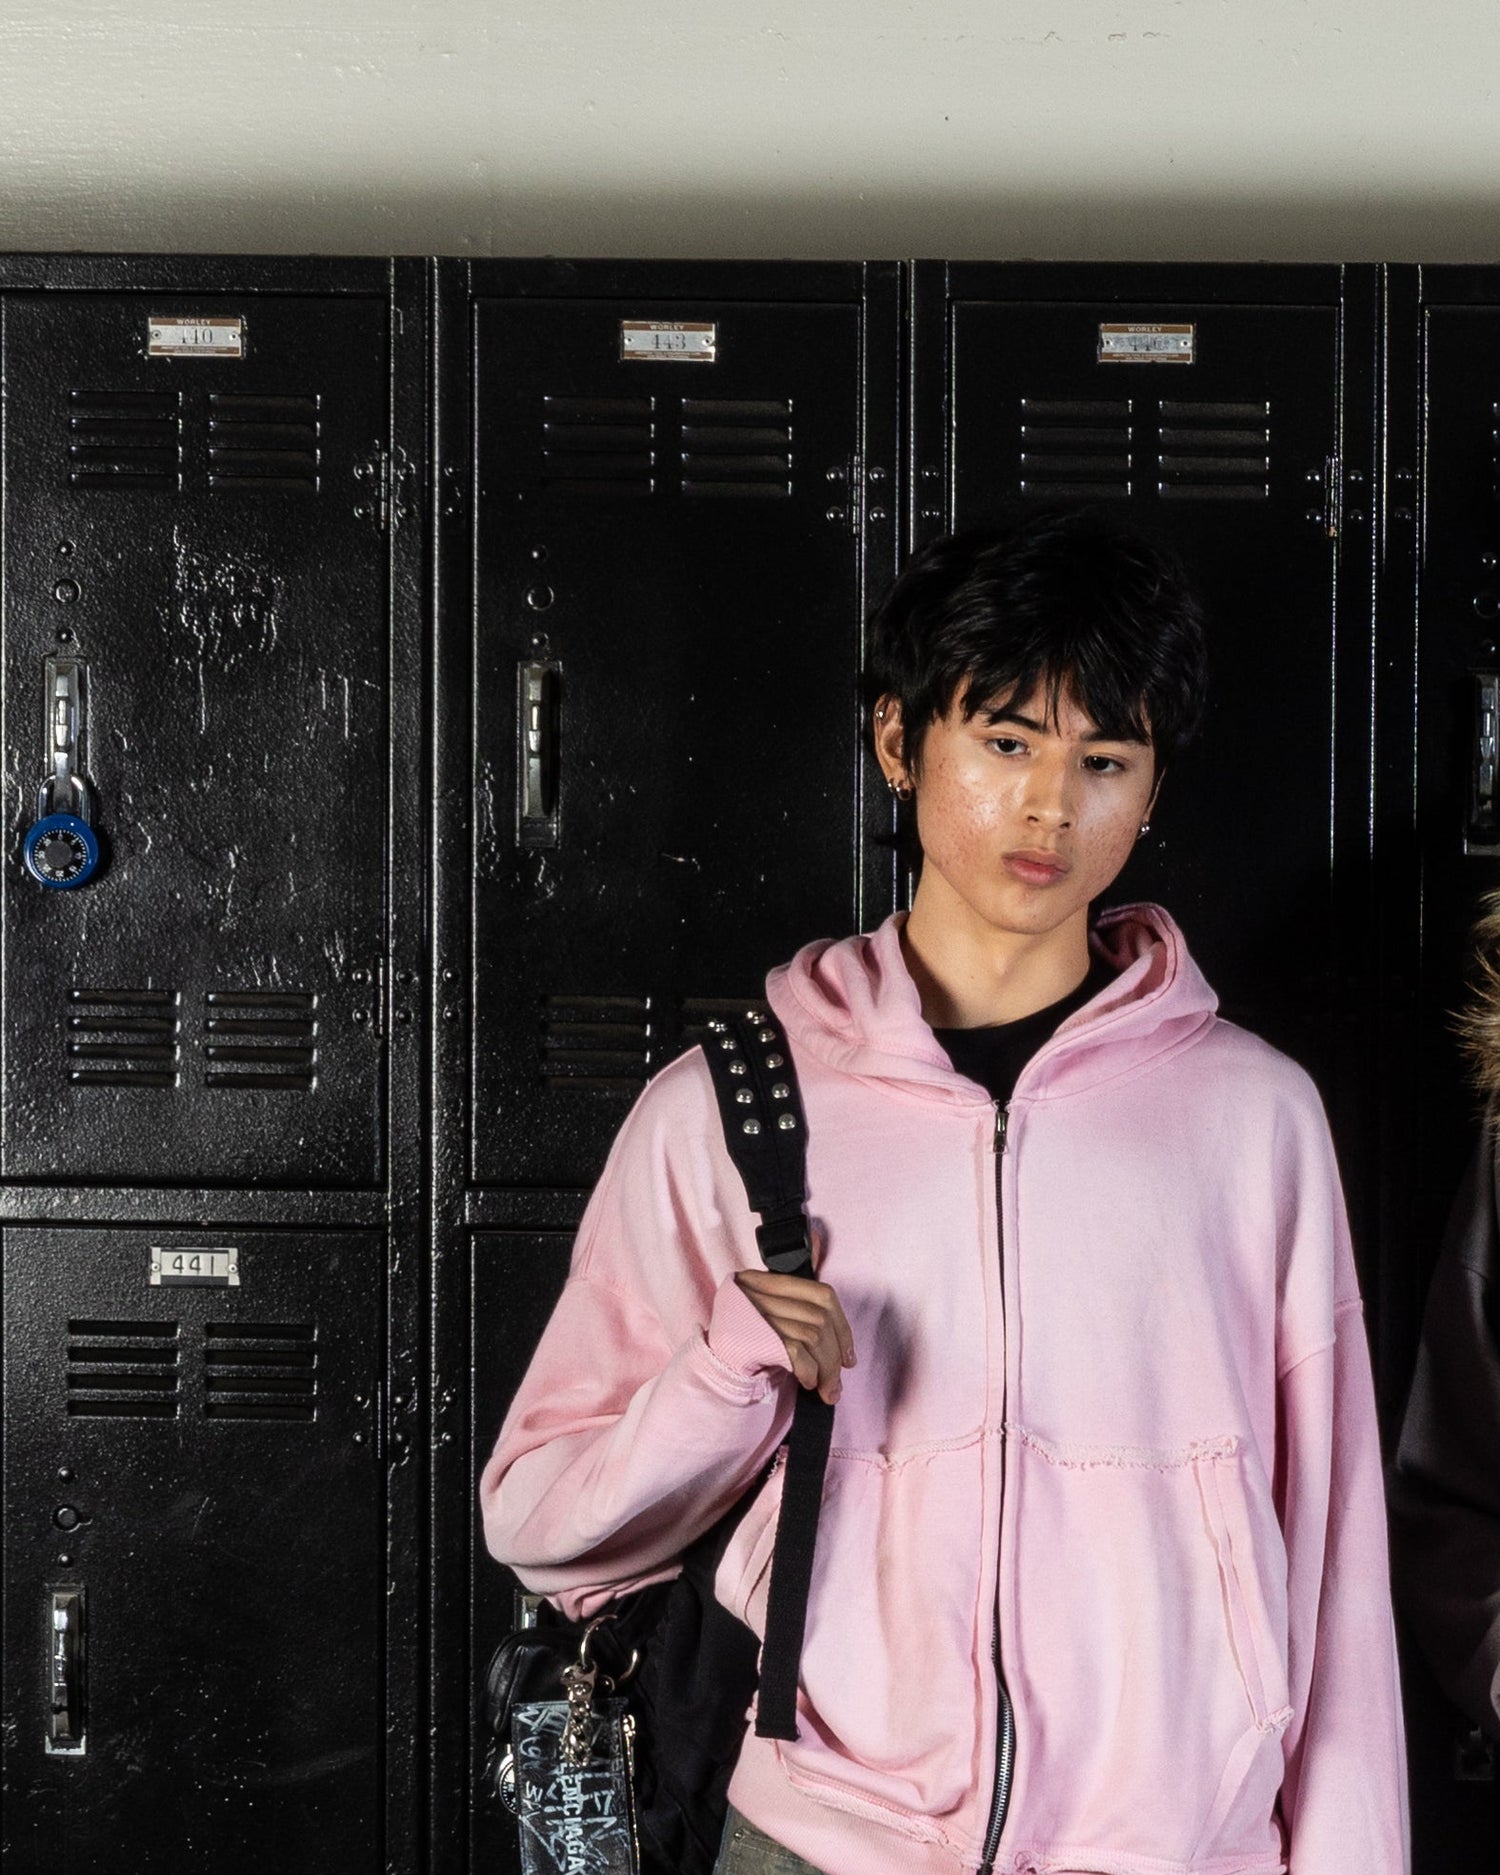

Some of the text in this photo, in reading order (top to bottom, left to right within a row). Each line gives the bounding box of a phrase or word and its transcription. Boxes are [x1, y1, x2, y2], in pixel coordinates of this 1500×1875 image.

[178, 328, 213, 344] 440
[651, 333, 686, 349] 443
[172, 1254, 214, 1275] 441
